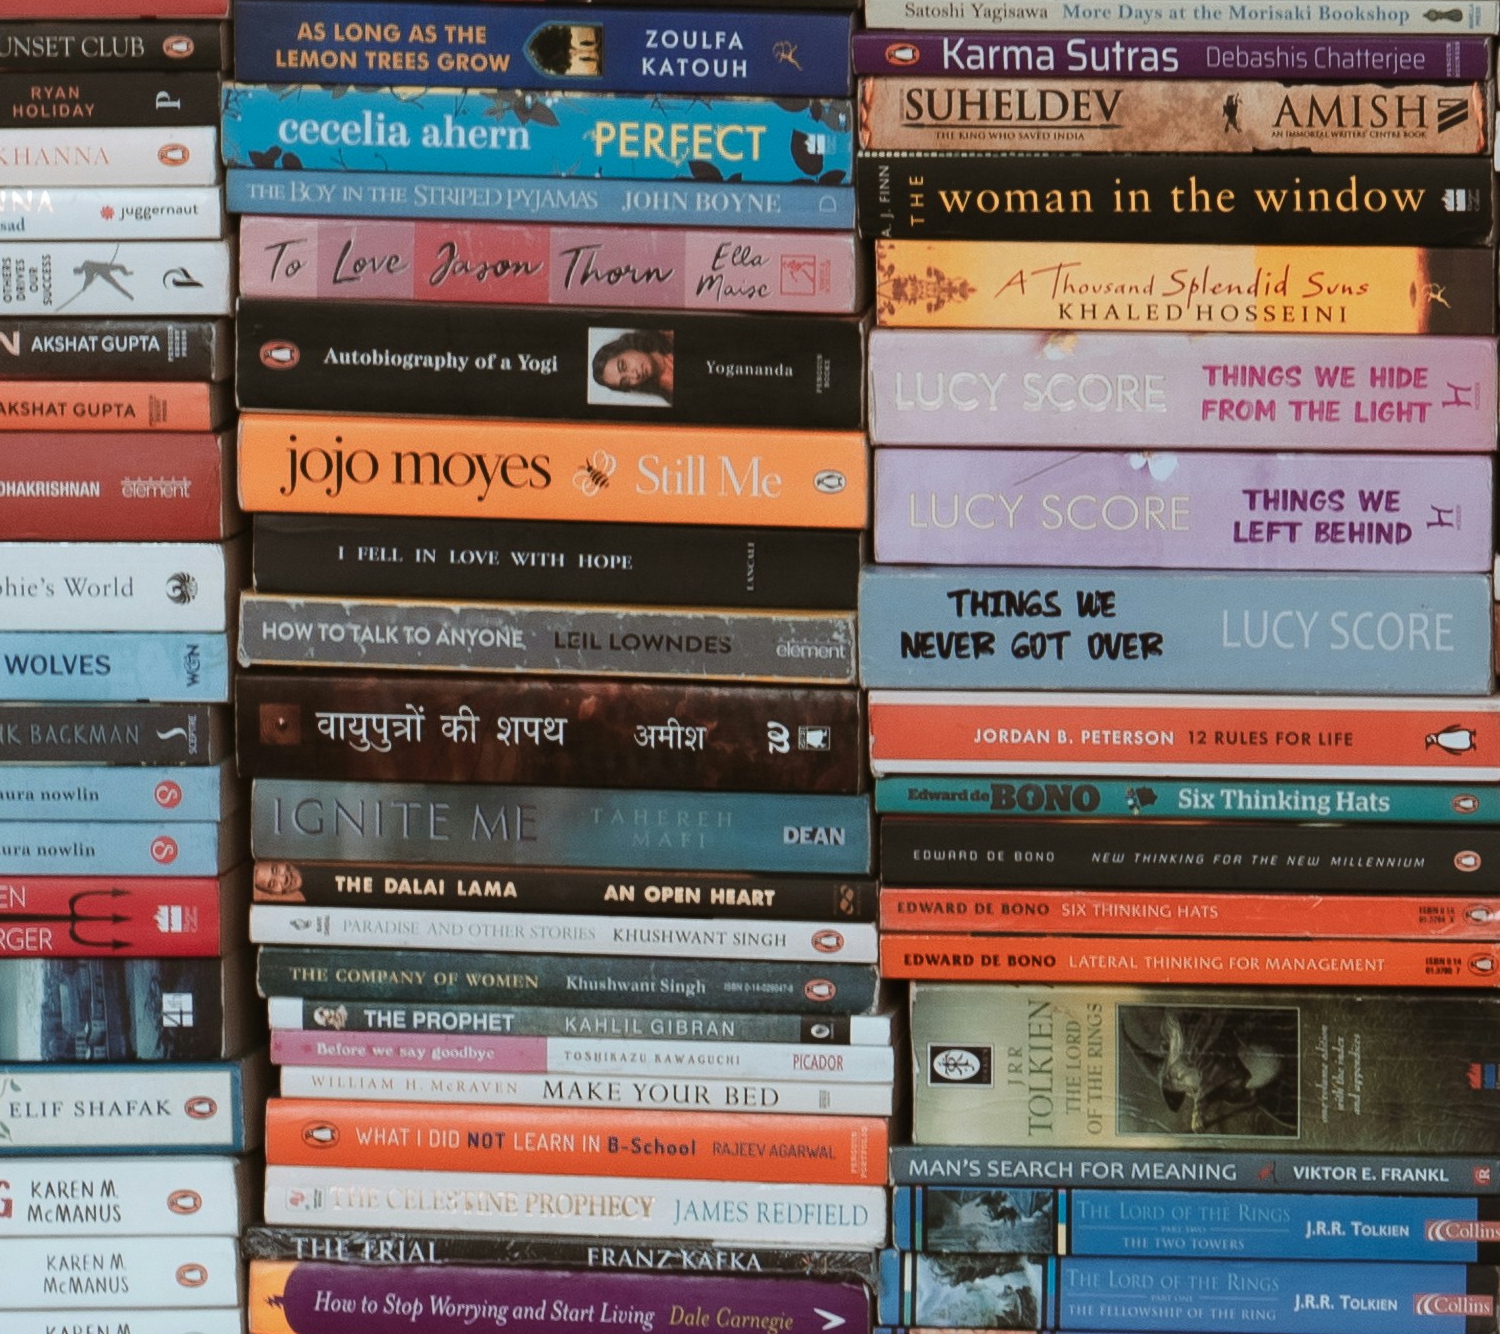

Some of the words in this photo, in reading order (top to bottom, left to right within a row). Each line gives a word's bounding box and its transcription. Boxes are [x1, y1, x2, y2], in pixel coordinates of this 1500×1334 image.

[940, 38, 1054, 73] Karma
[1065, 40, 1179, 74] Sutras
[1206, 45, 1308, 72] Debashis
[1314, 44, 1428, 75] Chatterjee
[278, 111, 408, 151] cecelia
[415, 115, 532, 152] ahern
[594, 120, 766, 161] PERFECT
[279, 435, 376, 499] jojo
[390, 453, 551, 498] moyes
[634, 451, 708, 496] Still
[717, 456, 783, 498] Me
[440, 705, 479, 745] की
[495, 714, 568, 750] शपथ
[634, 721, 707, 755] अमीश
